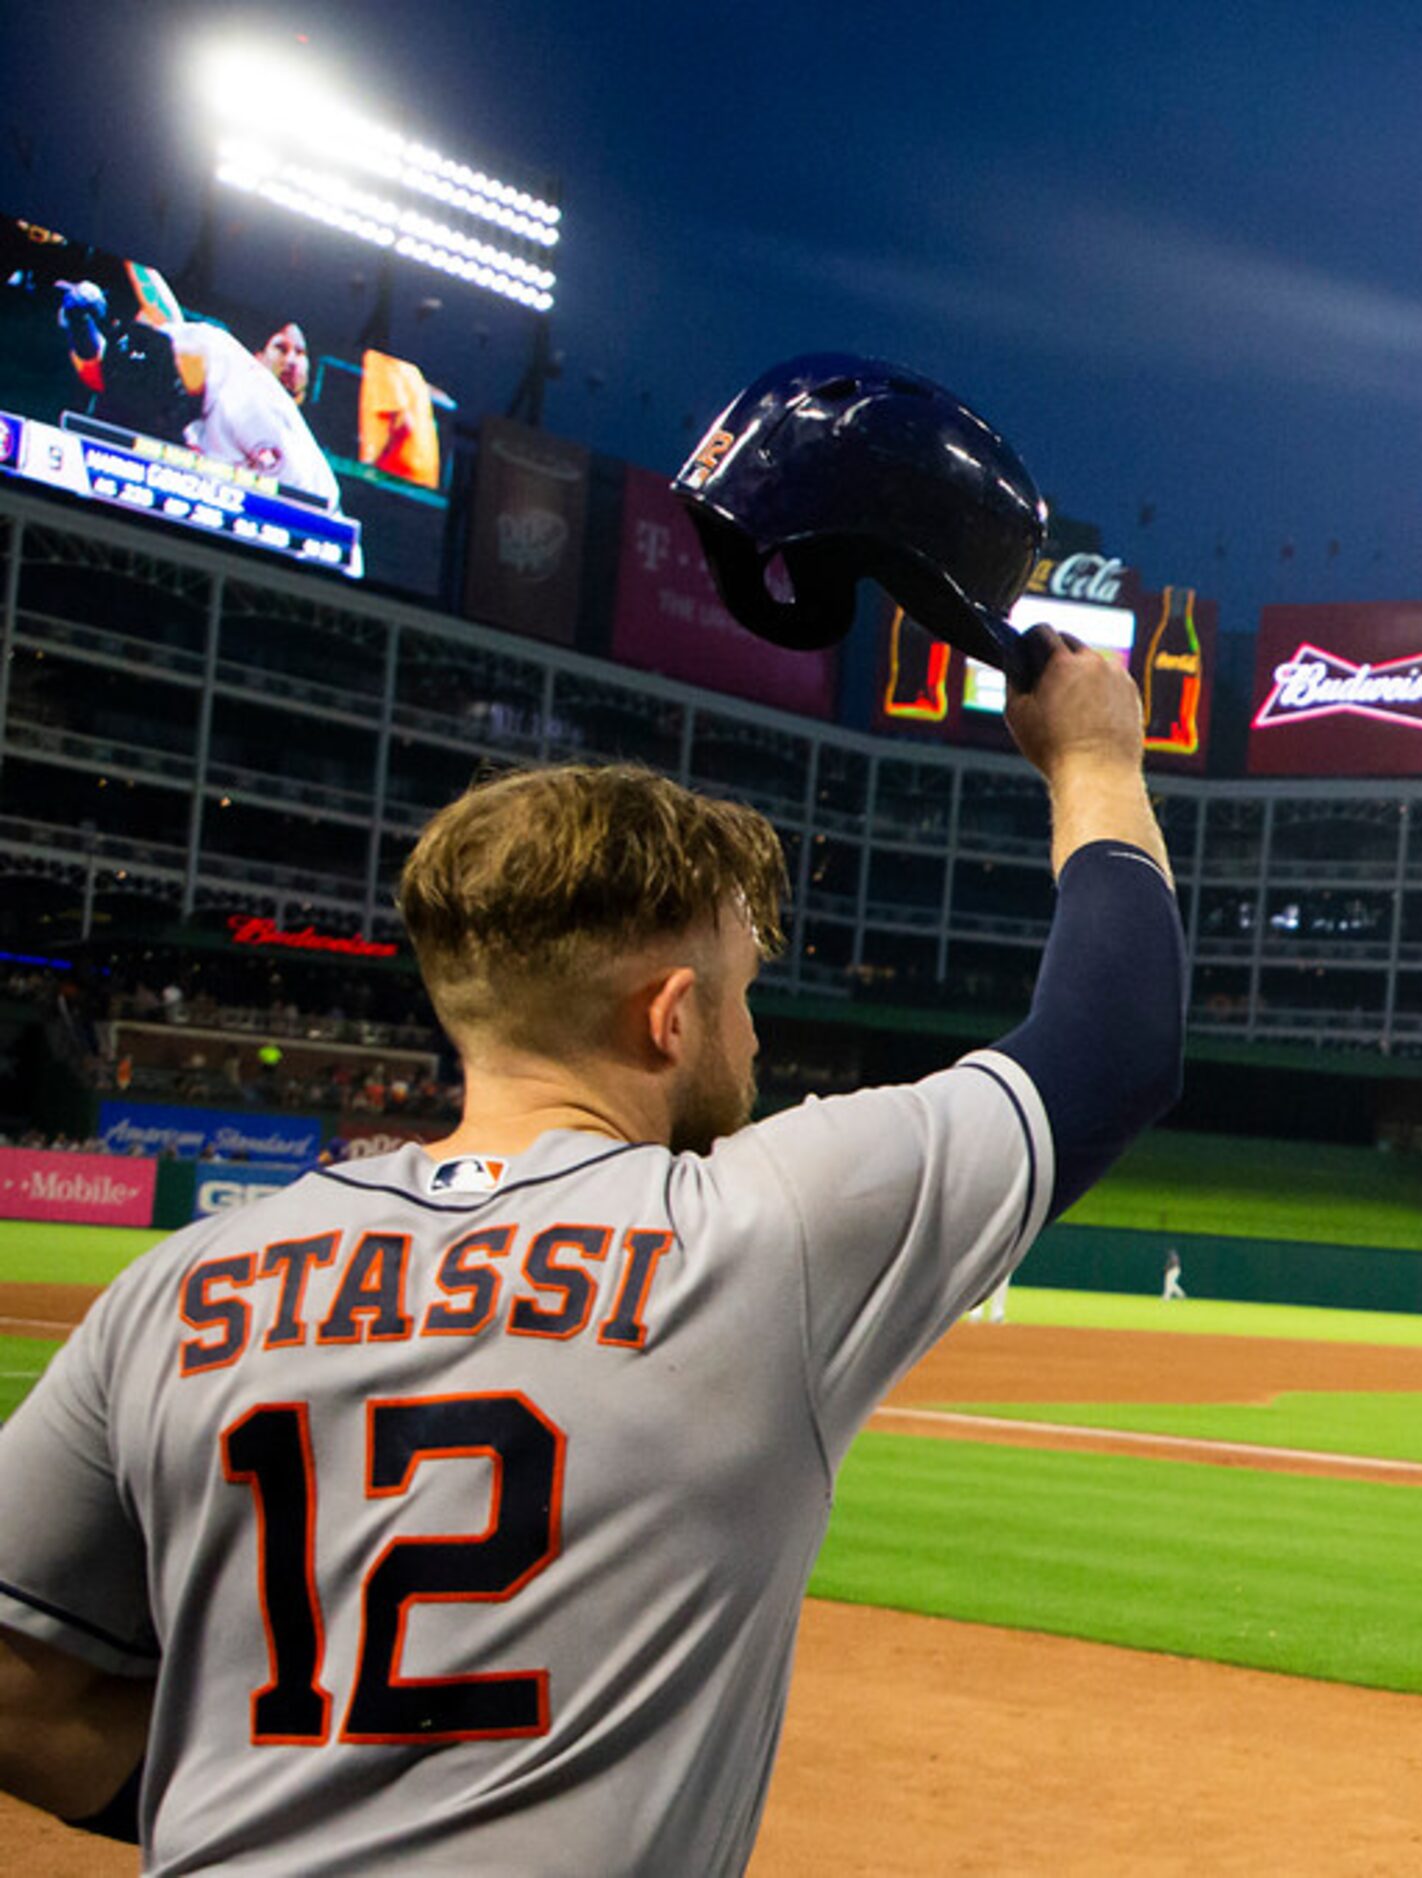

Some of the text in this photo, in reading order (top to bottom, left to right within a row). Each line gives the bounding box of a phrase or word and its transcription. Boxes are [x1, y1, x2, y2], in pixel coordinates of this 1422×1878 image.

[227, 914, 398, 957] Budweiser
[107, 1118, 204, 1150] American
[214, 1126, 314, 1155] Standard
[179, 1223, 677, 1378] STASSI
[219, 1389, 568, 1748] 12
